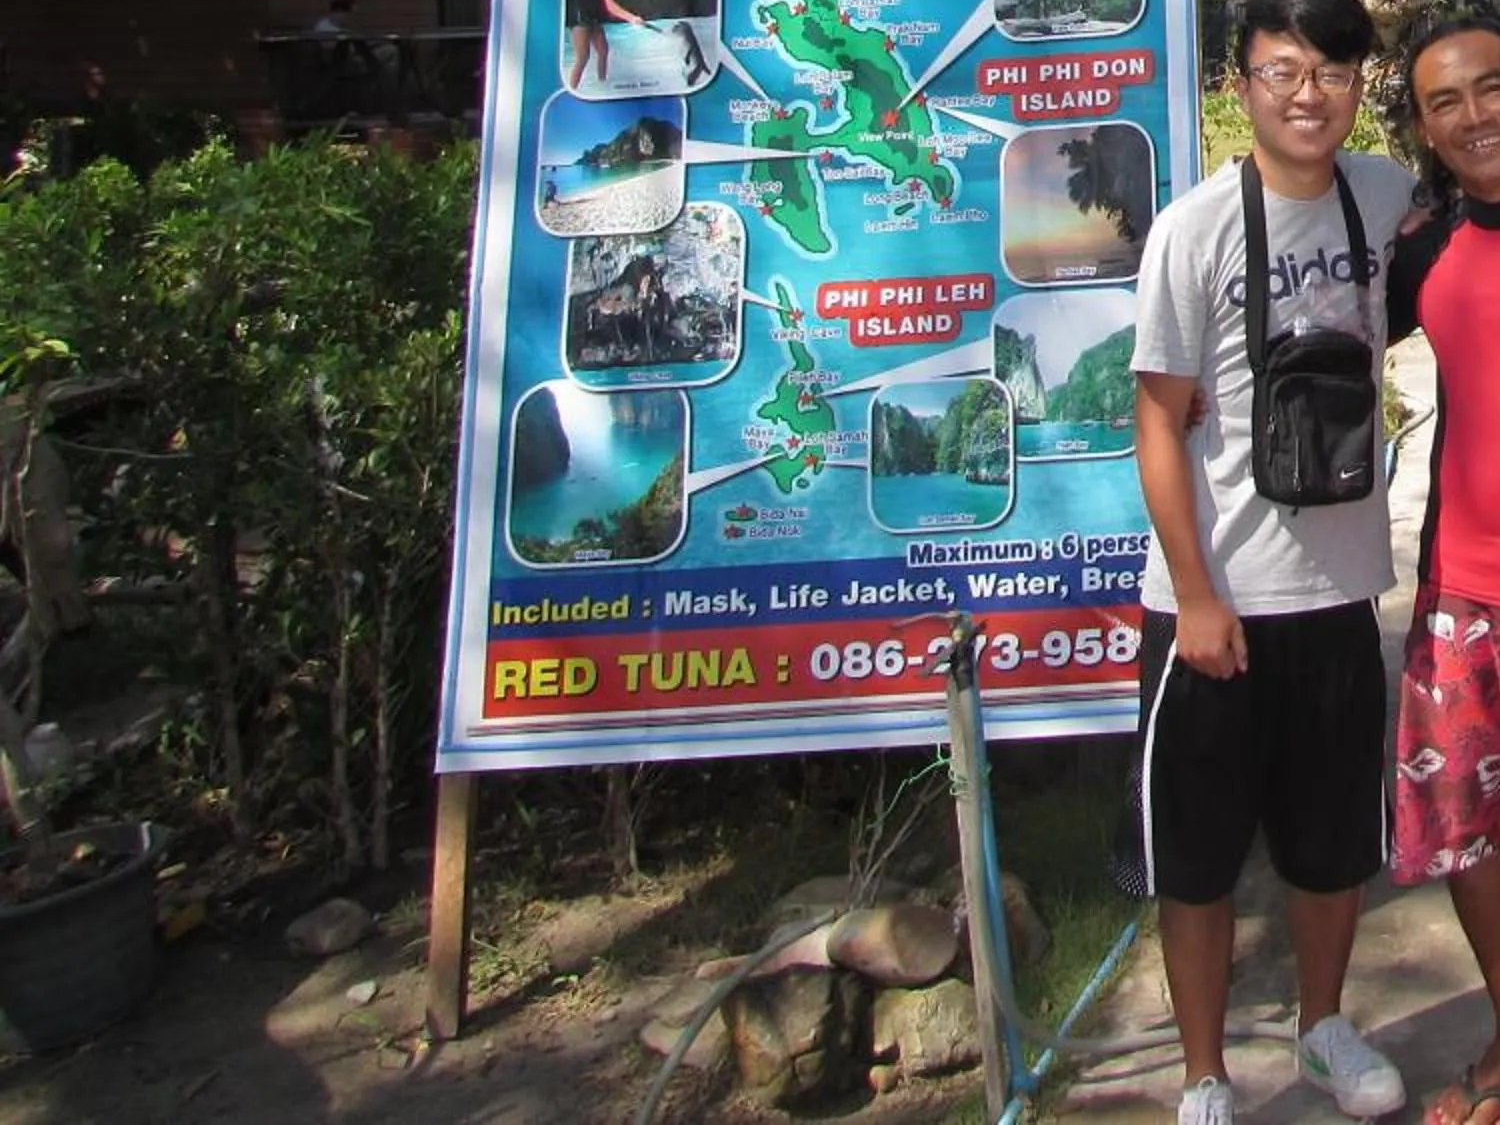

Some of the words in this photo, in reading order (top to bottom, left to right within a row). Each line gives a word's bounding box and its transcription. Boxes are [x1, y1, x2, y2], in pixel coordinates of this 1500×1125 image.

[985, 66, 1028, 86] PHI
[1039, 62, 1081, 82] PHI
[1093, 58, 1145, 77] DON
[1021, 89, 1111, 112] ISLAND
[824, 290, 868, 309] PHI
[880, 286, 923, 306] PHI
[935, 282, 985, 302] LEH
[857, 314, 953, 336] ISLAND
[909, 539, 1033, 565] Maximum
[1061, 534, 1079, 557] 6
[492, 595, 630, 625] Included
[665, 587, 757, 617] Mask,
[770, 583, 829, 610] Life
[842, 579, 956, 606] Jacket,
[968, 571, 1069, 598] Water,
[493, 657, 598, 699] RED
[618, 648, 756, 693] TUNA
